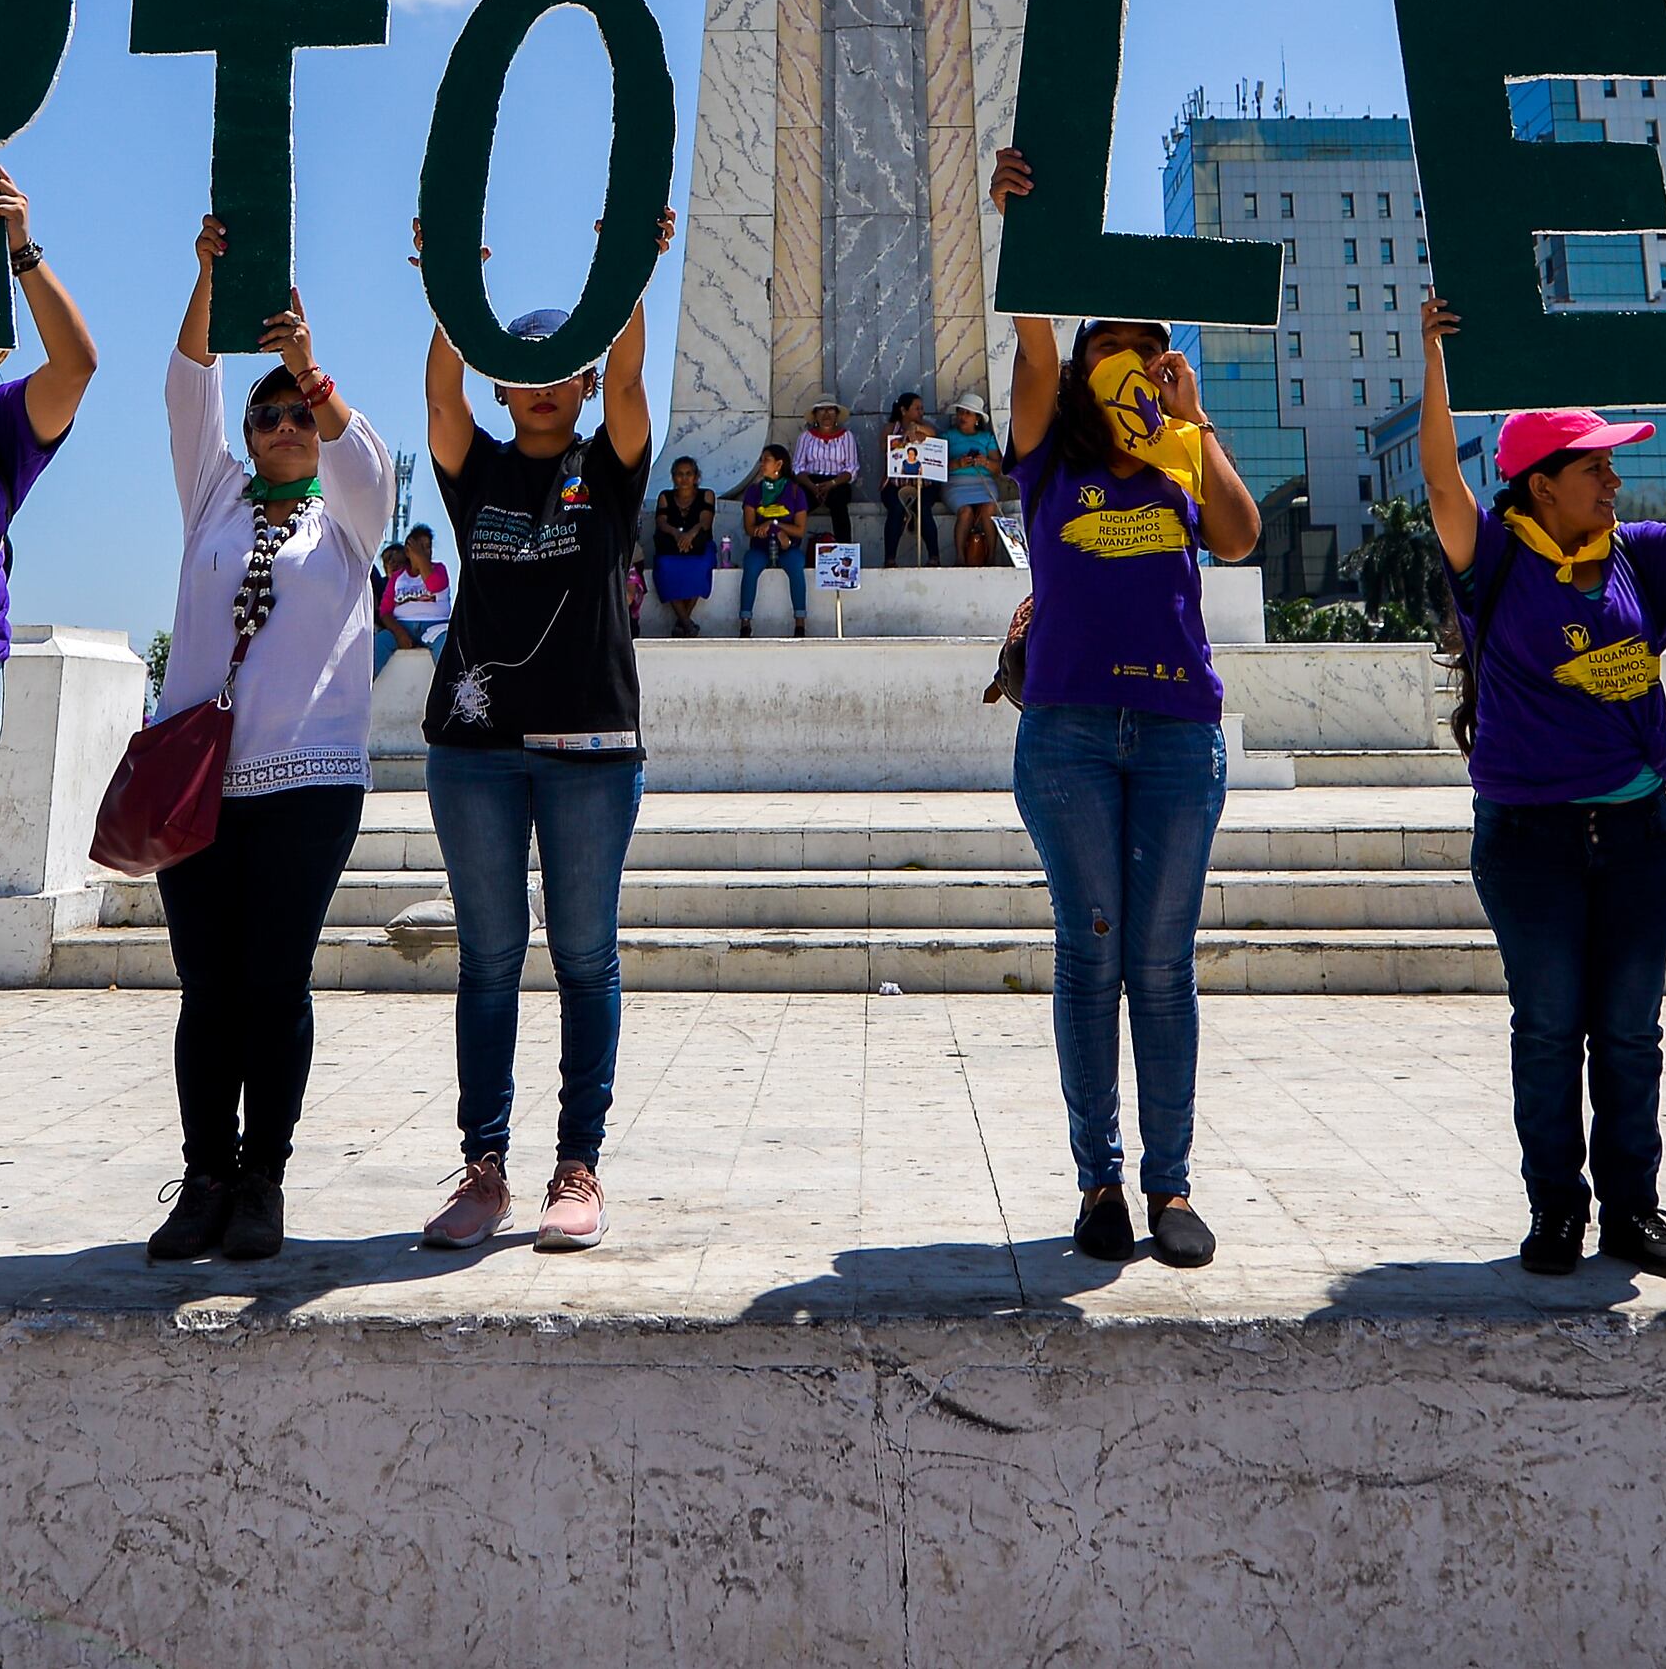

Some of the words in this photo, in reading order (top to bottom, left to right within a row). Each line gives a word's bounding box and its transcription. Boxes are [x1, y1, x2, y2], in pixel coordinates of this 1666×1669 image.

[1100, 509, 1161, 524] LUCHAMOS
[1099, 522, 1161, 536] RESISTIMOS
[1095, 534, 1164, 547] AVANZAMOS
